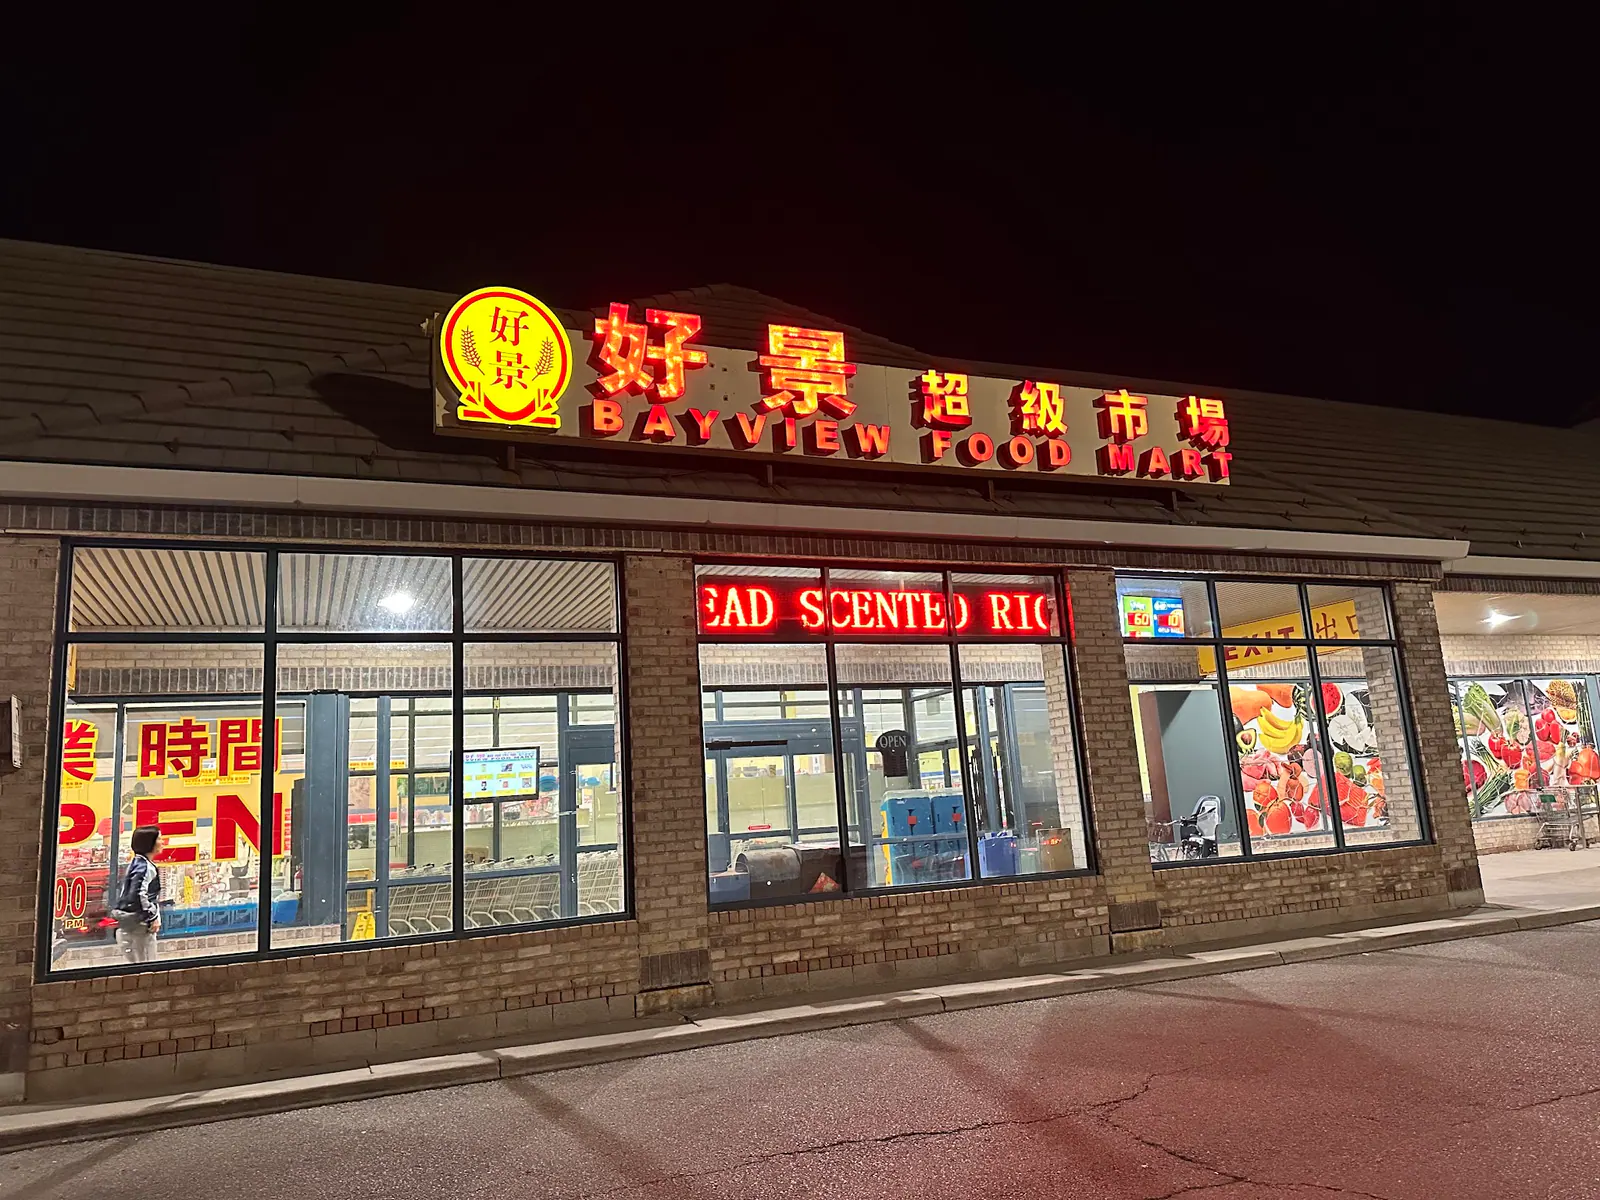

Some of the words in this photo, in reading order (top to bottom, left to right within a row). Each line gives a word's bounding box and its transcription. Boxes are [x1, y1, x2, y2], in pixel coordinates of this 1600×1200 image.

[489, 306, 531, 390] 好景
[593, 399, 890, 456] BAYVIEW
[932, 430, 1072, 467] FOOD
[1107, 443, 1233, 478] MART
[799, 590, 969, 629] SCENTED
[880, 735, 907, 748] OPEN
[65, 919, 84, 928] PM
